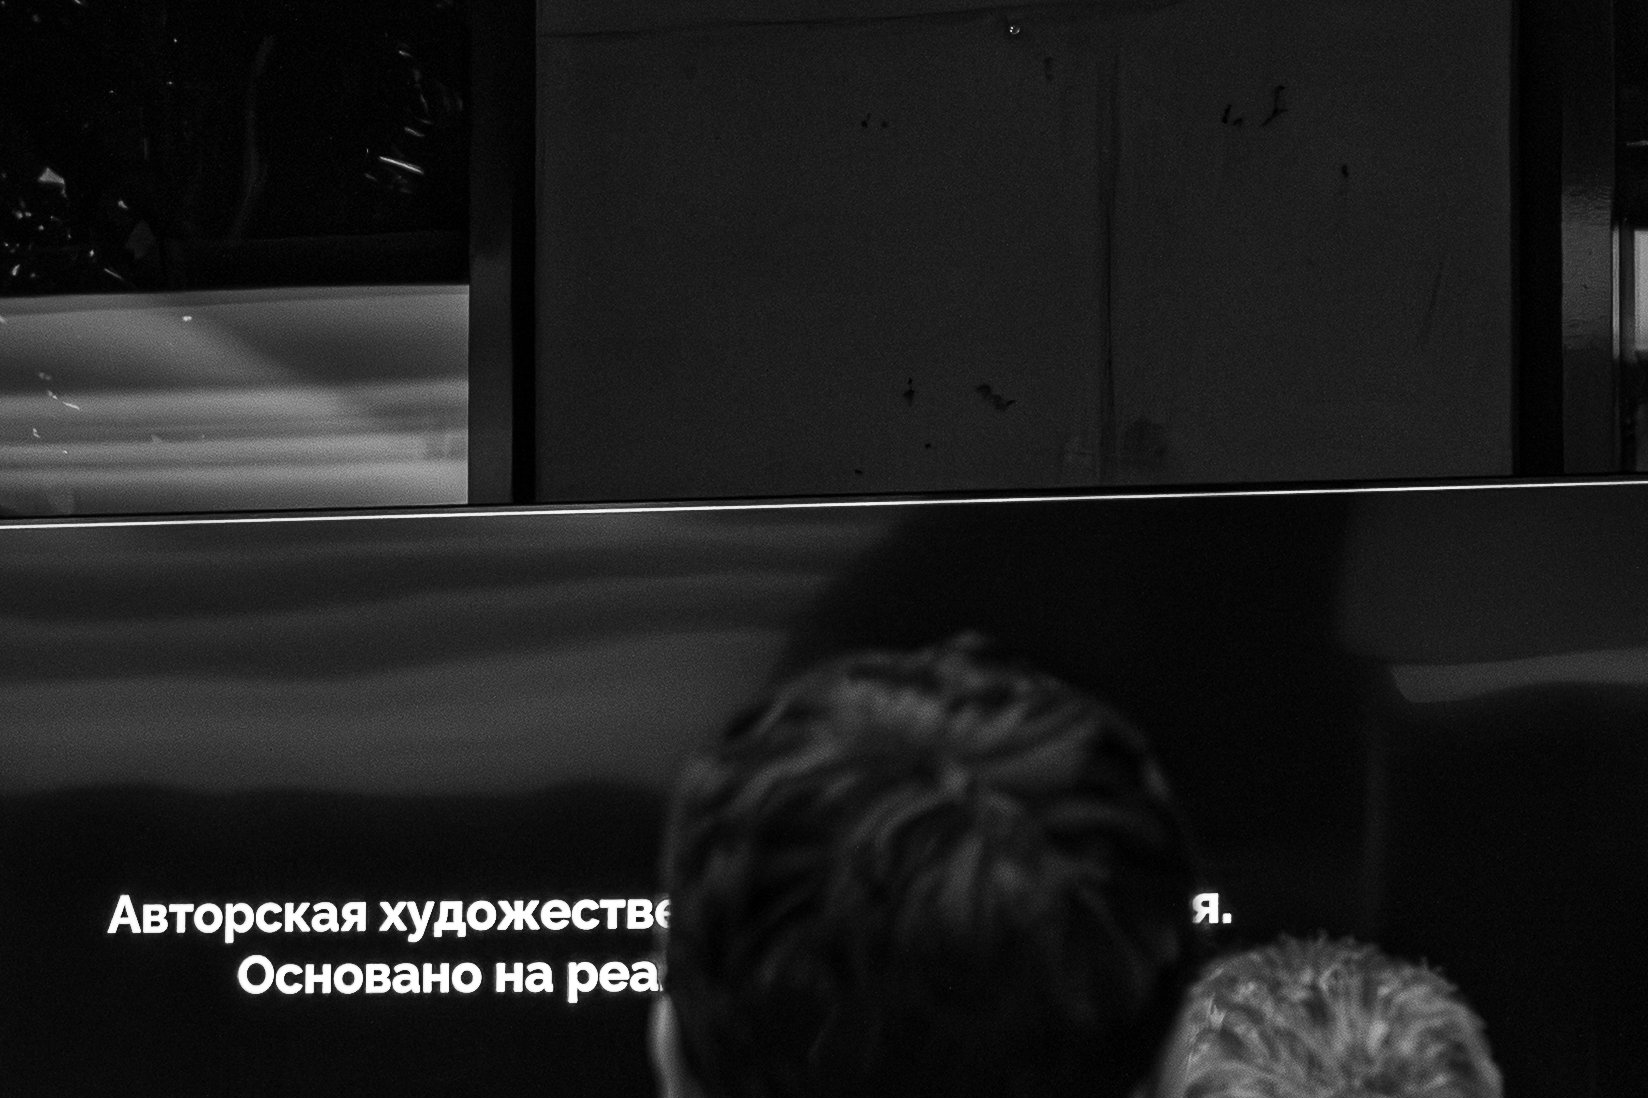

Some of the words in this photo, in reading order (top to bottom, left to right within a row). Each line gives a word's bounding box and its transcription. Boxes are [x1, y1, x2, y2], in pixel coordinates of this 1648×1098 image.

[106, 894, 367, 945] Авторская
[236, 954, 483, 995] Основано
[495, 961, 554, 994] на
[566, 960, 664, 1004] реа
